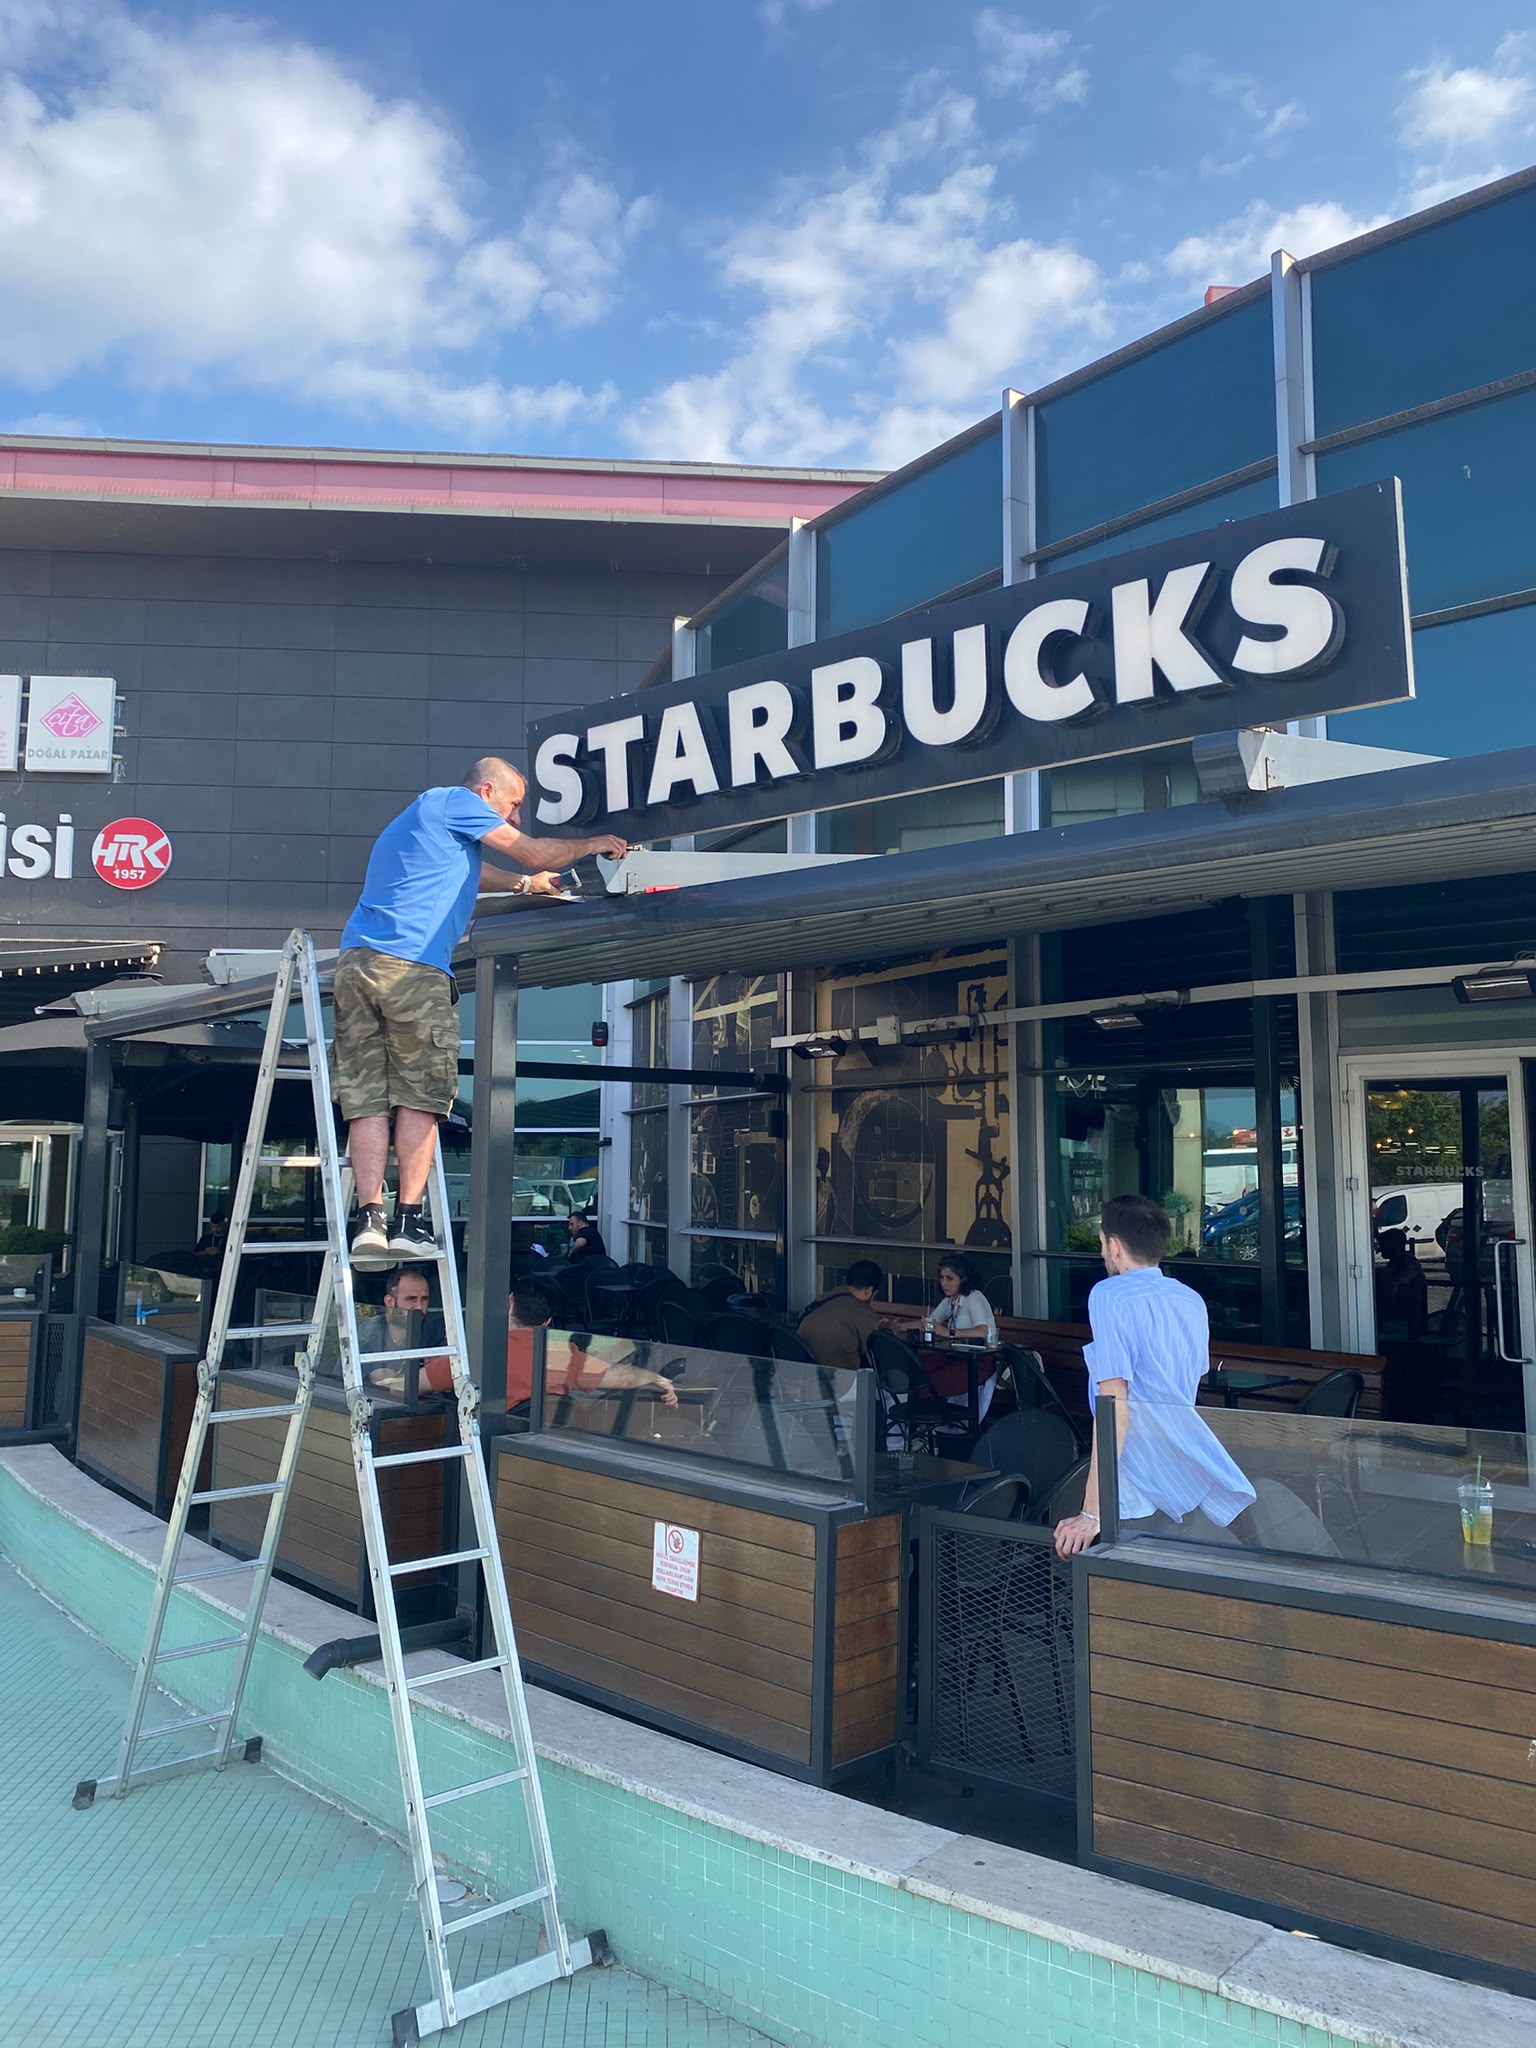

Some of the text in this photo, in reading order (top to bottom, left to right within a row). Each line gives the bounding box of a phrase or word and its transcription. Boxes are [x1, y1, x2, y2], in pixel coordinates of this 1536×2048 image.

[534, 537, 1340, 827] STARBUCKS
[28, 747, 108, 760] DOĞAL PAZAR
[92, 833, 171, 869] HRK
[113, 869, 147, 880] 1957
[1396, 1165, 1484, 1178] STARBUCKS
